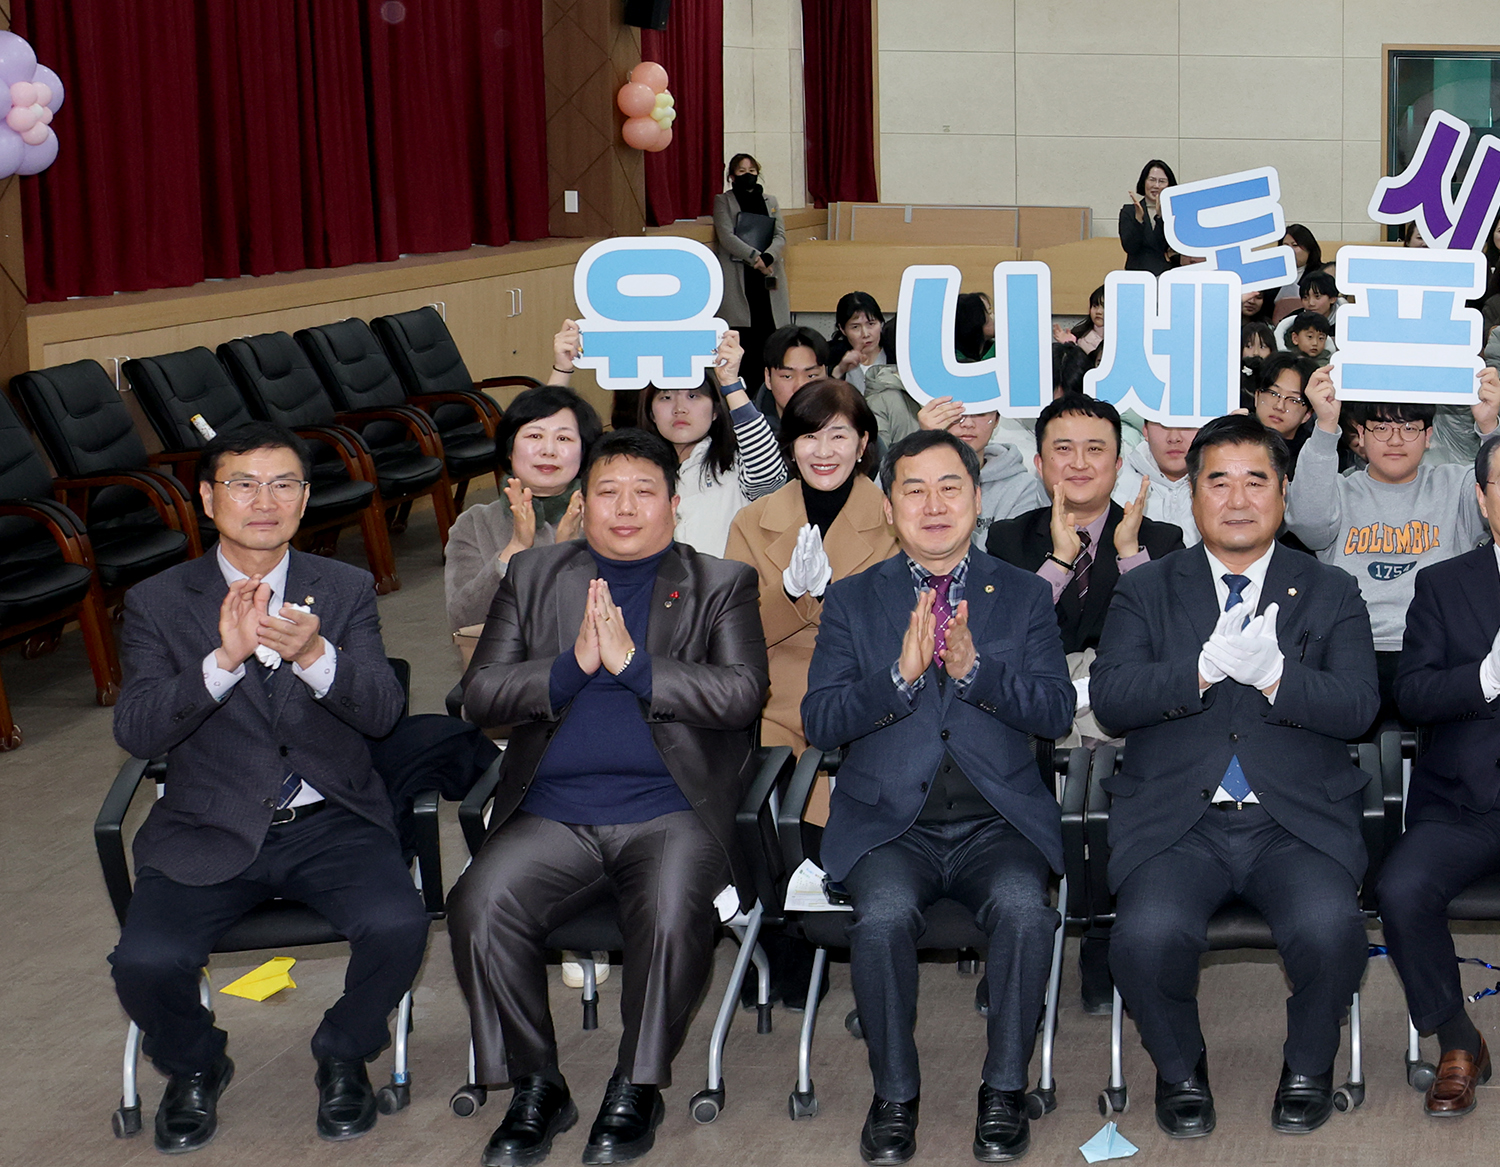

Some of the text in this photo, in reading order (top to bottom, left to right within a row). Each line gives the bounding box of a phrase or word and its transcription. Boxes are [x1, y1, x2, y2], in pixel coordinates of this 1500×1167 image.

[1170, 176, 1287, 284] 도
[577, 248, 717, 379] 유
[908, 273, 1041, 408] 니
[1094, 282, 1229, 417] 세
[1341, 257, 1475, 393] 프
